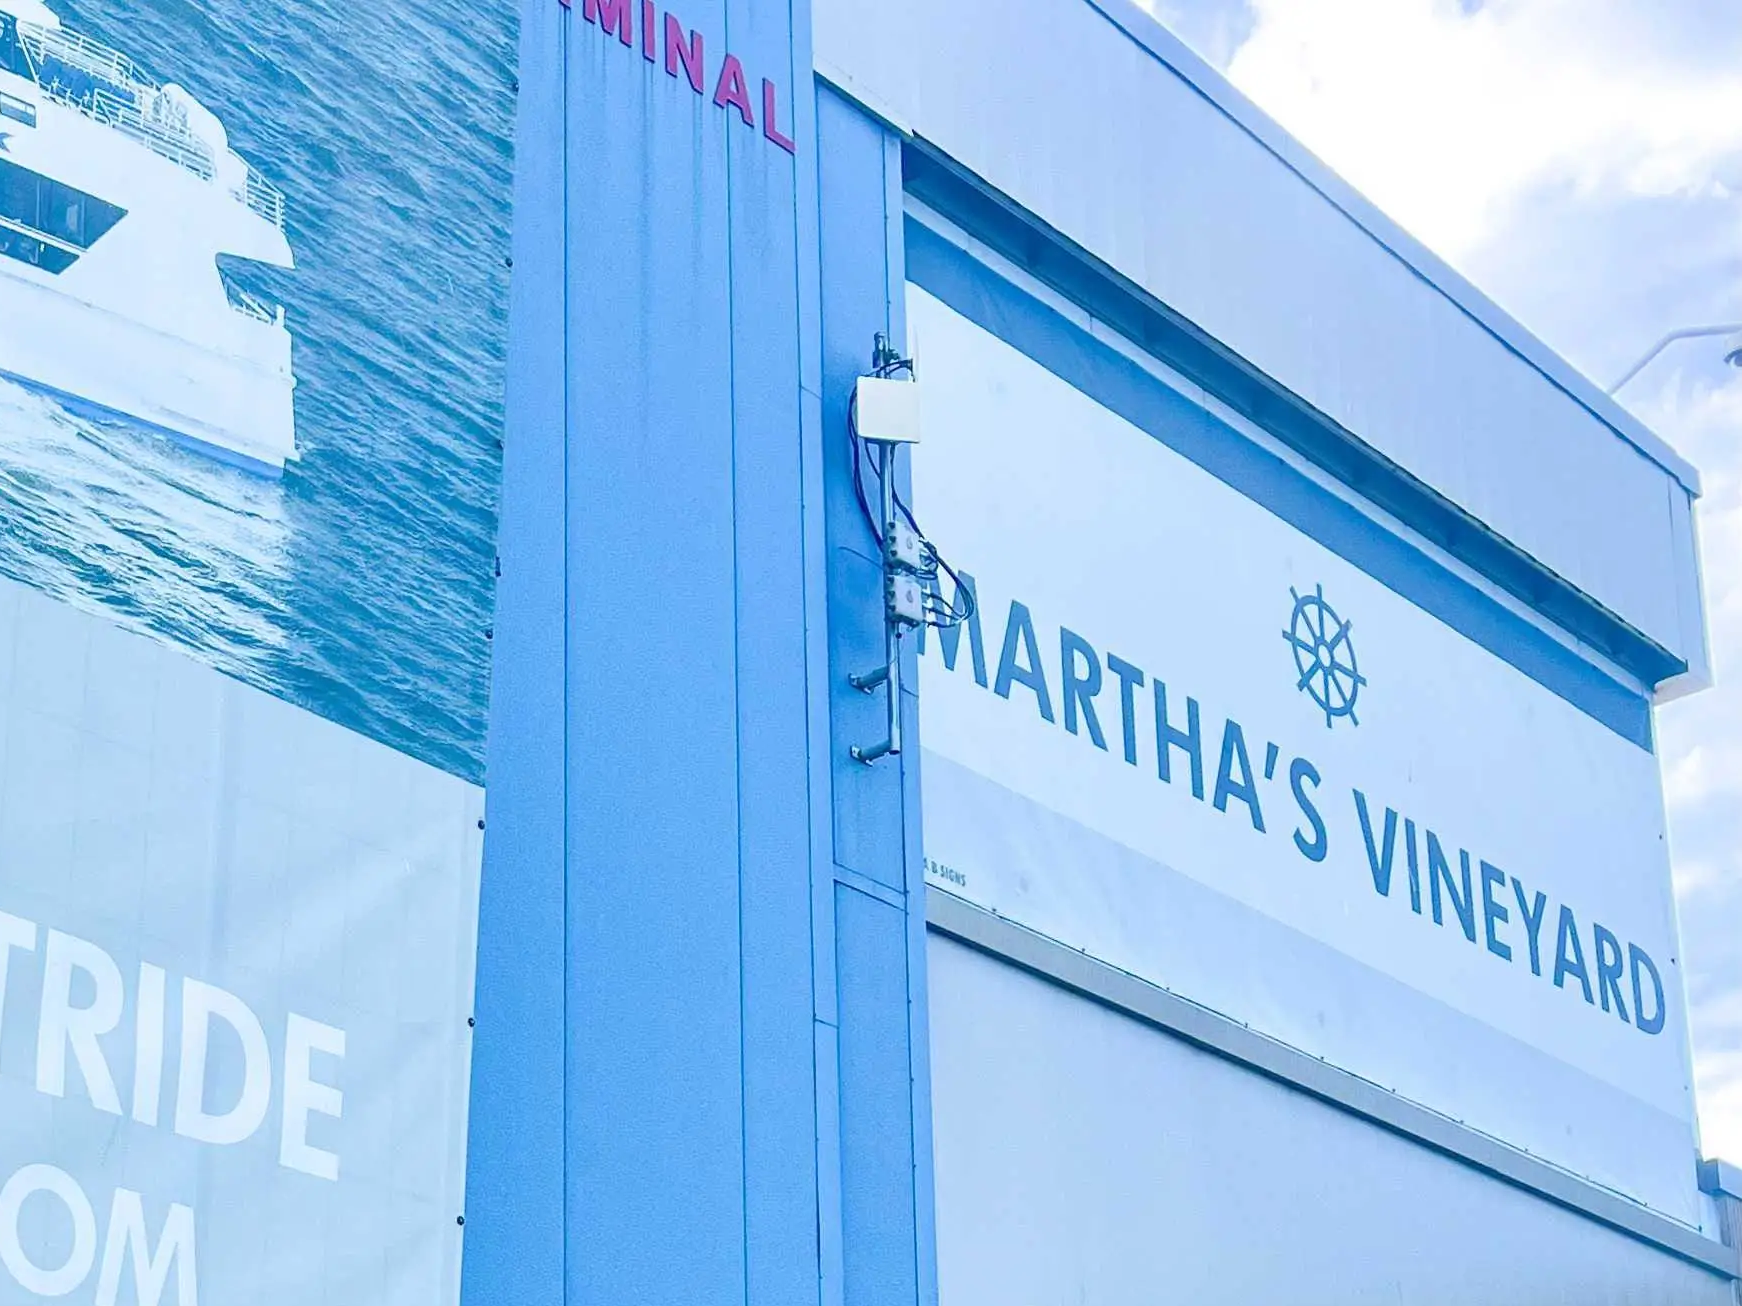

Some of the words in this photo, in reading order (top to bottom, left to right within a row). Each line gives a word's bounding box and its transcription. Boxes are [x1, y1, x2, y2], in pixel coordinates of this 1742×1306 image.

[559, 0, 796, 154] MINAL
[917, 569, 1328, 862] MARTHA'S
[1352, 788, 1666, 1035] VINEYARD
